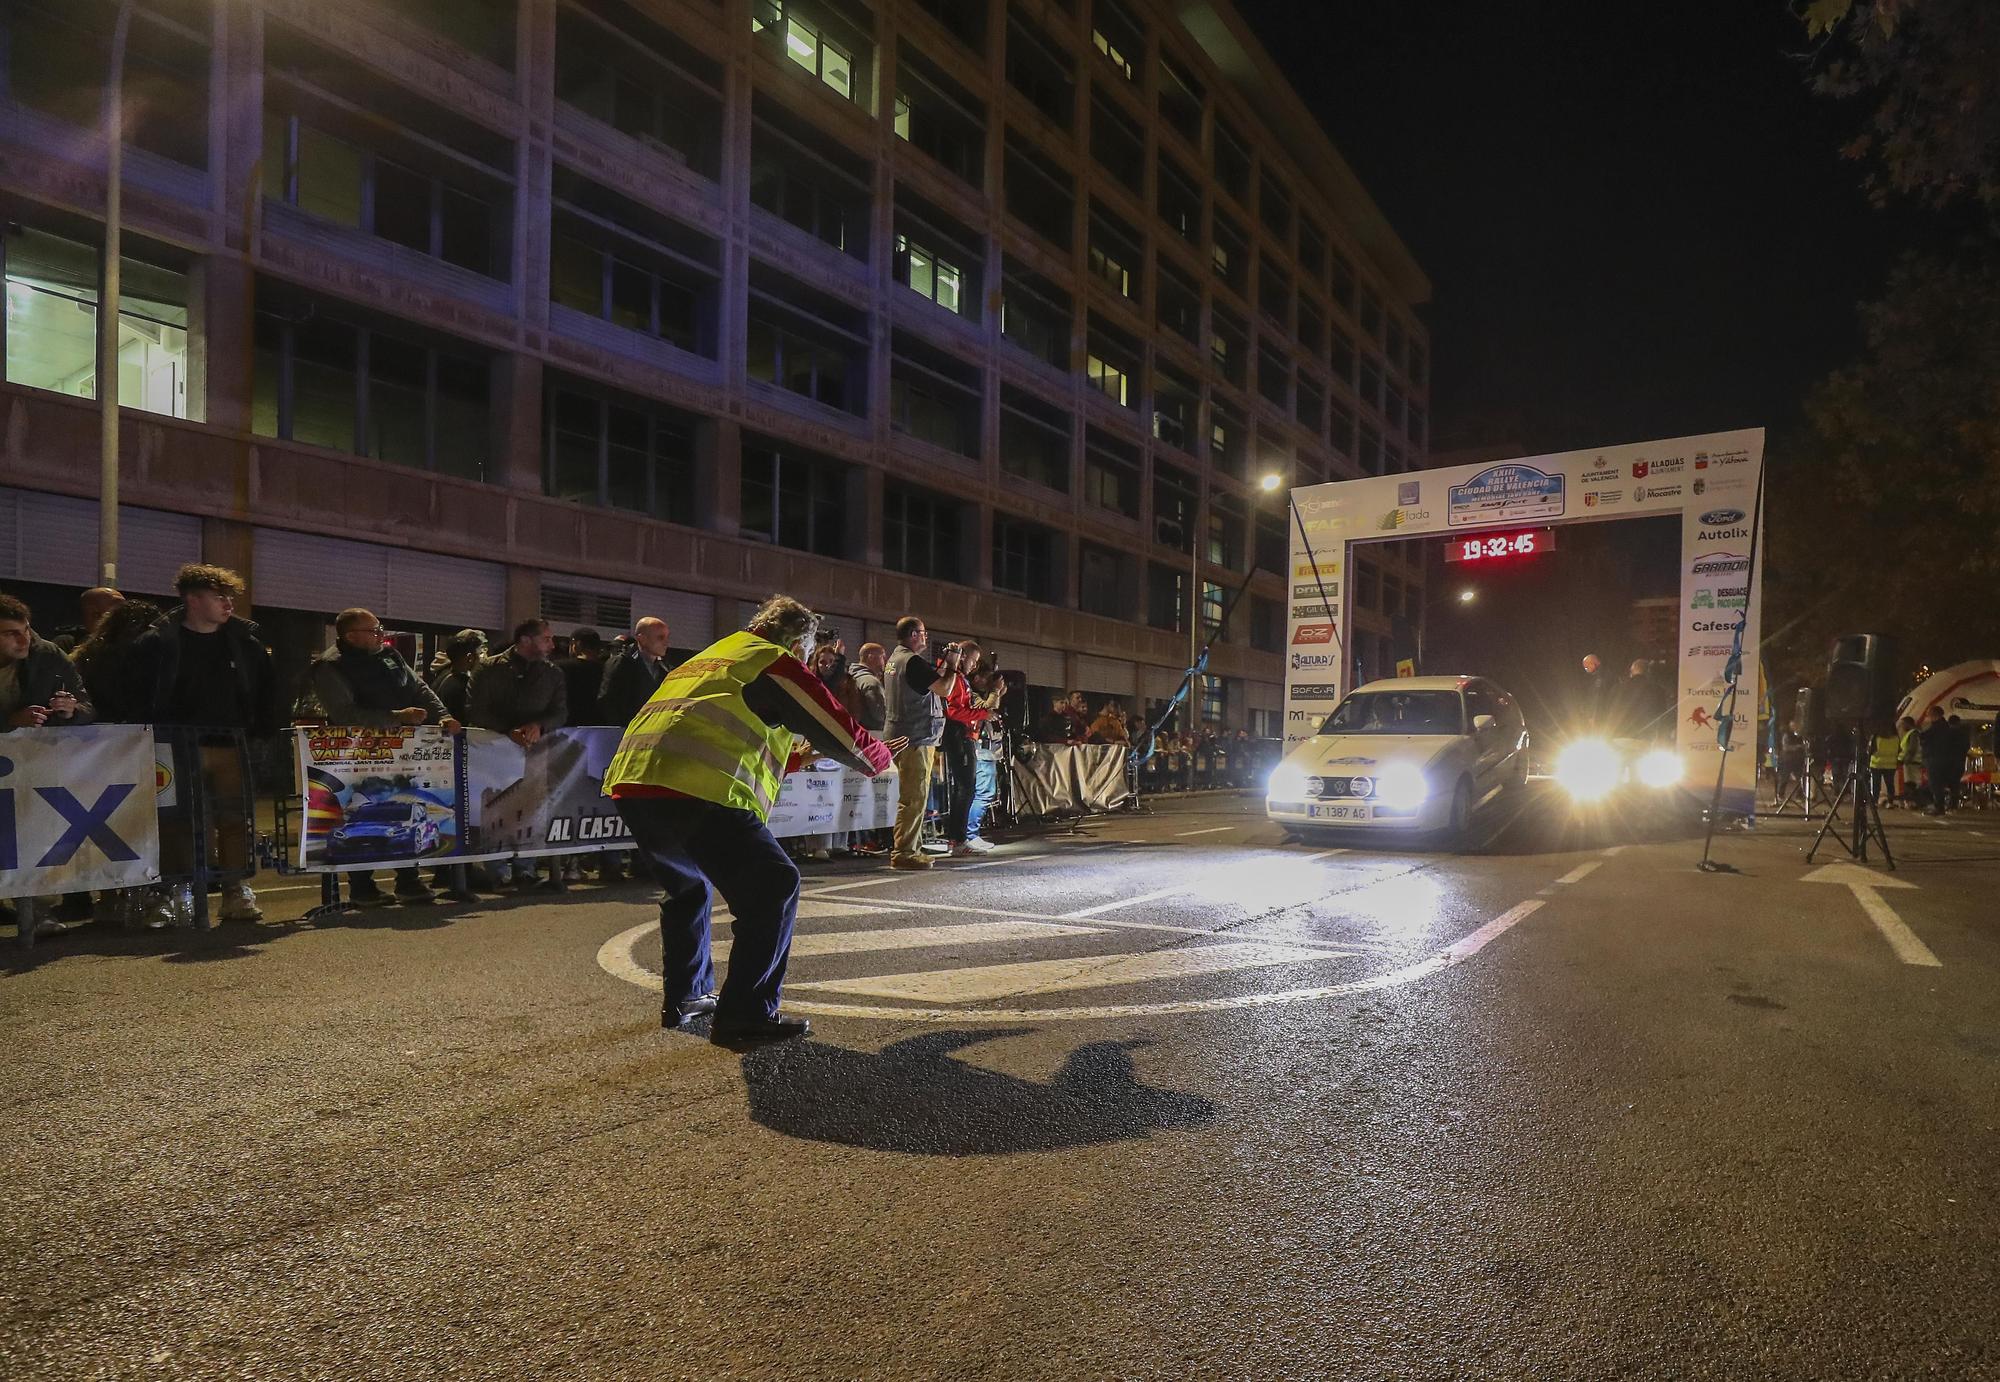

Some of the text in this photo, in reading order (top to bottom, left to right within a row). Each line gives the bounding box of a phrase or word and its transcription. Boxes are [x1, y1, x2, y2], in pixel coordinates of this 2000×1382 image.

[1493, 468, 1516, 477] XXIII
[1581, 468, 1619, 478] AJUNTAMENT
[1488, 475, 1520, 486] RALLYE
[1458, 484, 1491, 496] CIUDAD
[1493, 482, 1505, 493] DE
[1708, 512, 1736, 523] Ford
[1698, 528, 1748, 540] Autolix
[1463, 533, 1534, 560] 19:32:45
[1291, 686, 1335, 695] SOFCAR
[307, 727, 348, 738] XXIII
[351, 727, 416, 738] RALLYE
[309, 737, 404, 749] CIUDAD DE
[310, 749, 394, 761] VALENCIA
[1326, 807, 1348, 818] 1387
[1353, 809, 1365, 818] AG
[547, 819, 572, 842] AL
